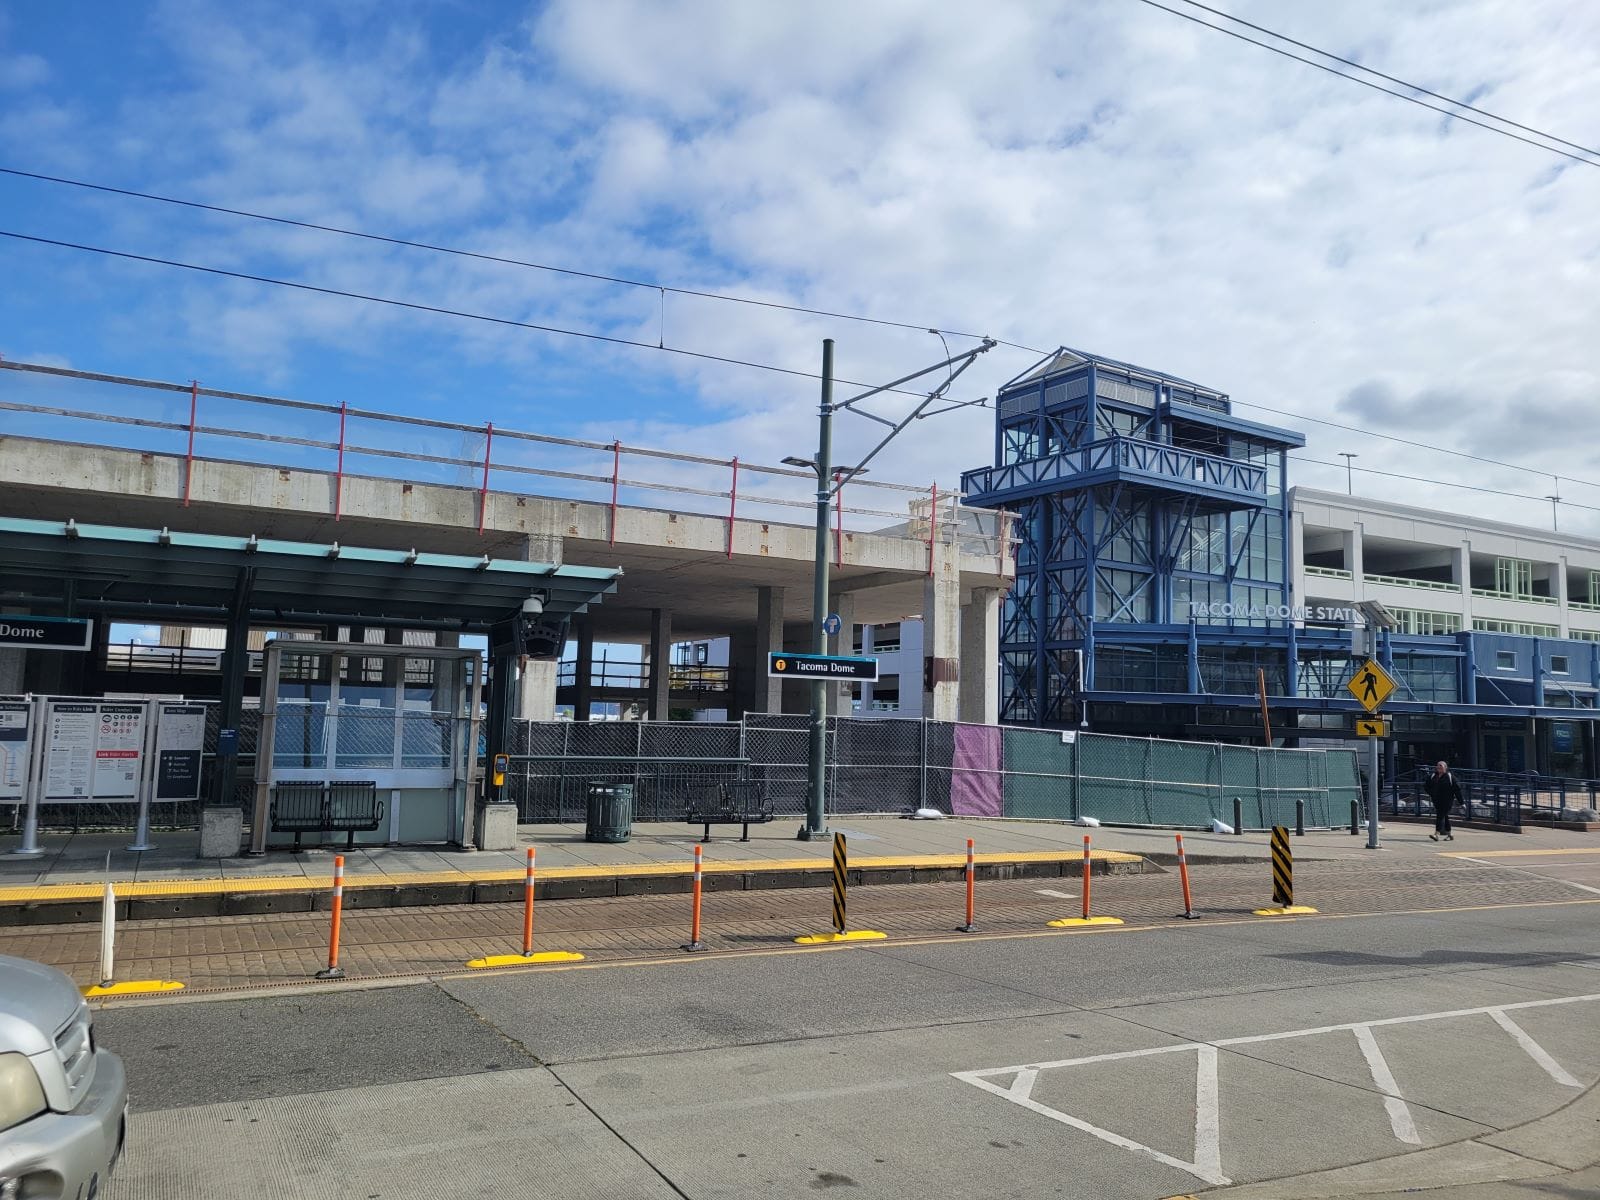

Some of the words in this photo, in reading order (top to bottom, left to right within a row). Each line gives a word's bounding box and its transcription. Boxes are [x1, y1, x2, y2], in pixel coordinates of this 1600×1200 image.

[1190, 601, 1261, 617] TACOMA
[1265, 604, 1313, 619] DOME
[1316, 606, 1361, 622] STATI
[0, 624, 45, 638] Dome
[795, 660, 828, 672] Tacoma
[830, 662, 855, 673] Dome
